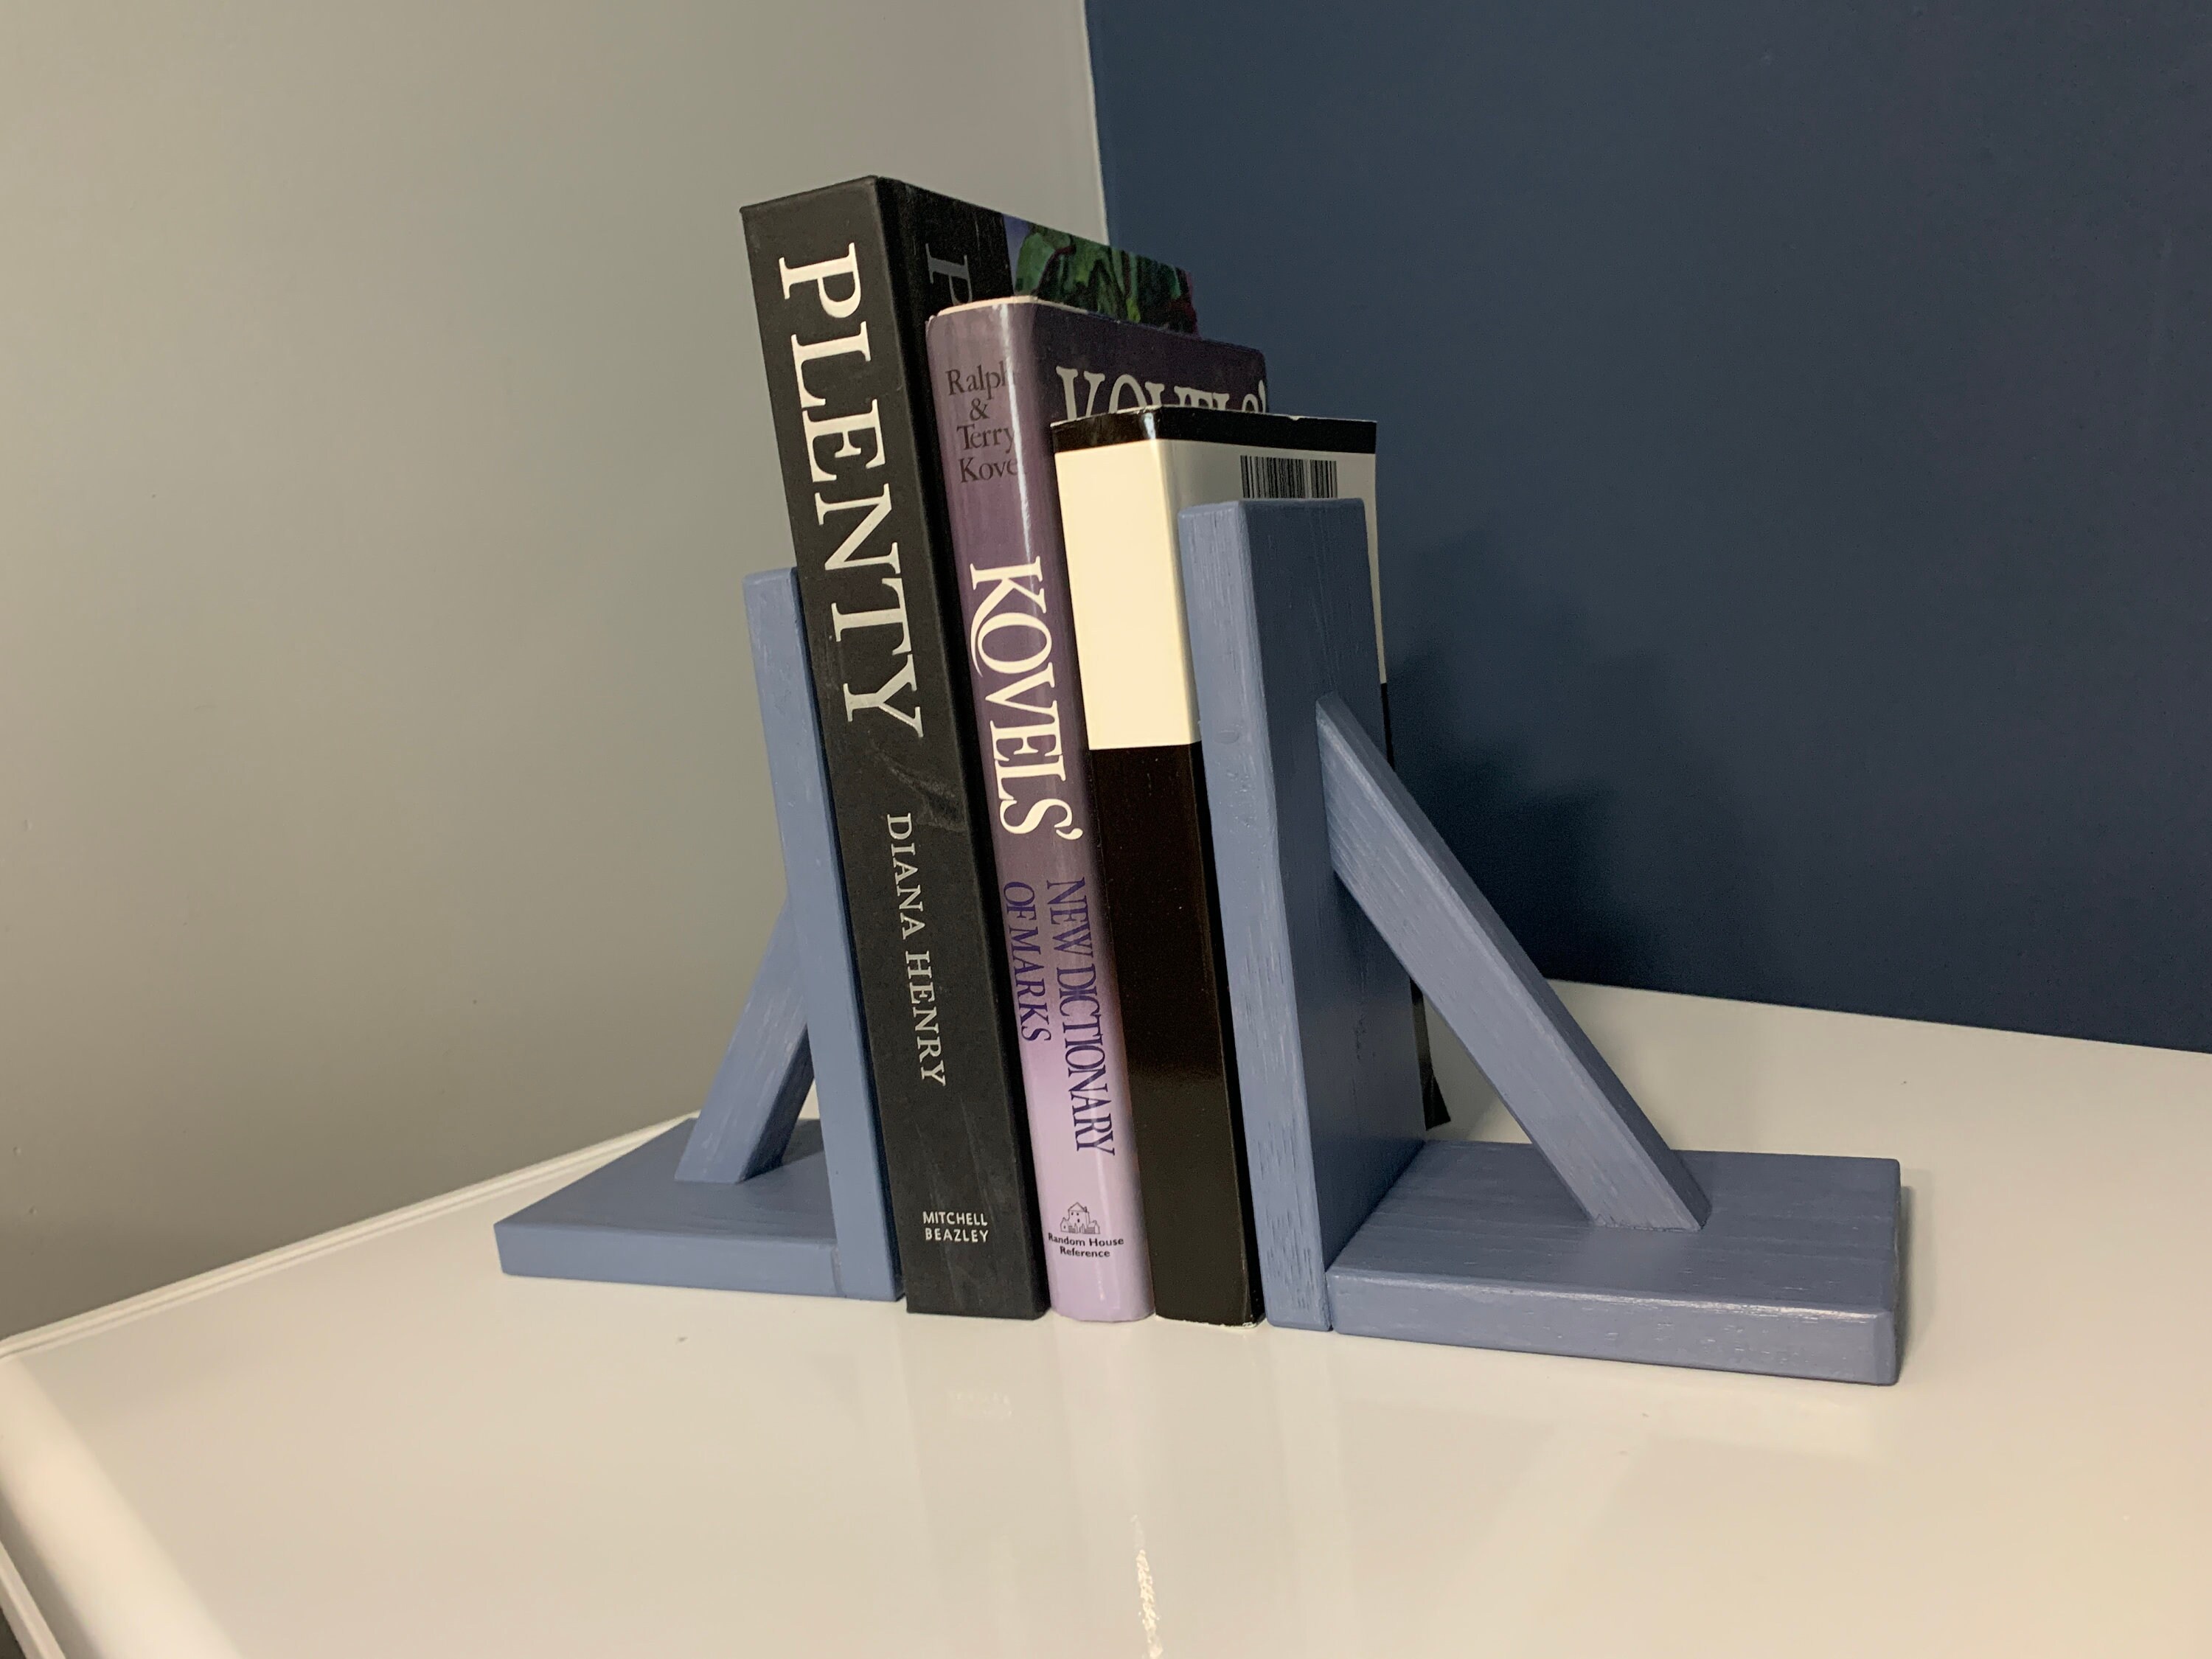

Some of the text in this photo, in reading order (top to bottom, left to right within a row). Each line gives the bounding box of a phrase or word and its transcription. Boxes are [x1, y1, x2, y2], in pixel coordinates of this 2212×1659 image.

[970, 398, 990, 421] &
[956, 423, 1016, 454] Terry
[959, 456, 1025, 484] Kove
[779, 242, 925, 737] PLENTY
[970, 555, 1083, 841] KOVELS'
[886, 813, 946, 1087] DIANA HENRY
[1004, 881, 1052, 1041] OF MARKS
[1046, 877, 1115, 1156] NEW DICTIONARY
[923, 1211, 988, 1226] MITCHELL
[925, 1228, 989, 1243] BEAZLEY
[1048, 1232, 1124, 1247] Random House
[1060, 1245, 1110, 1258] Reference
